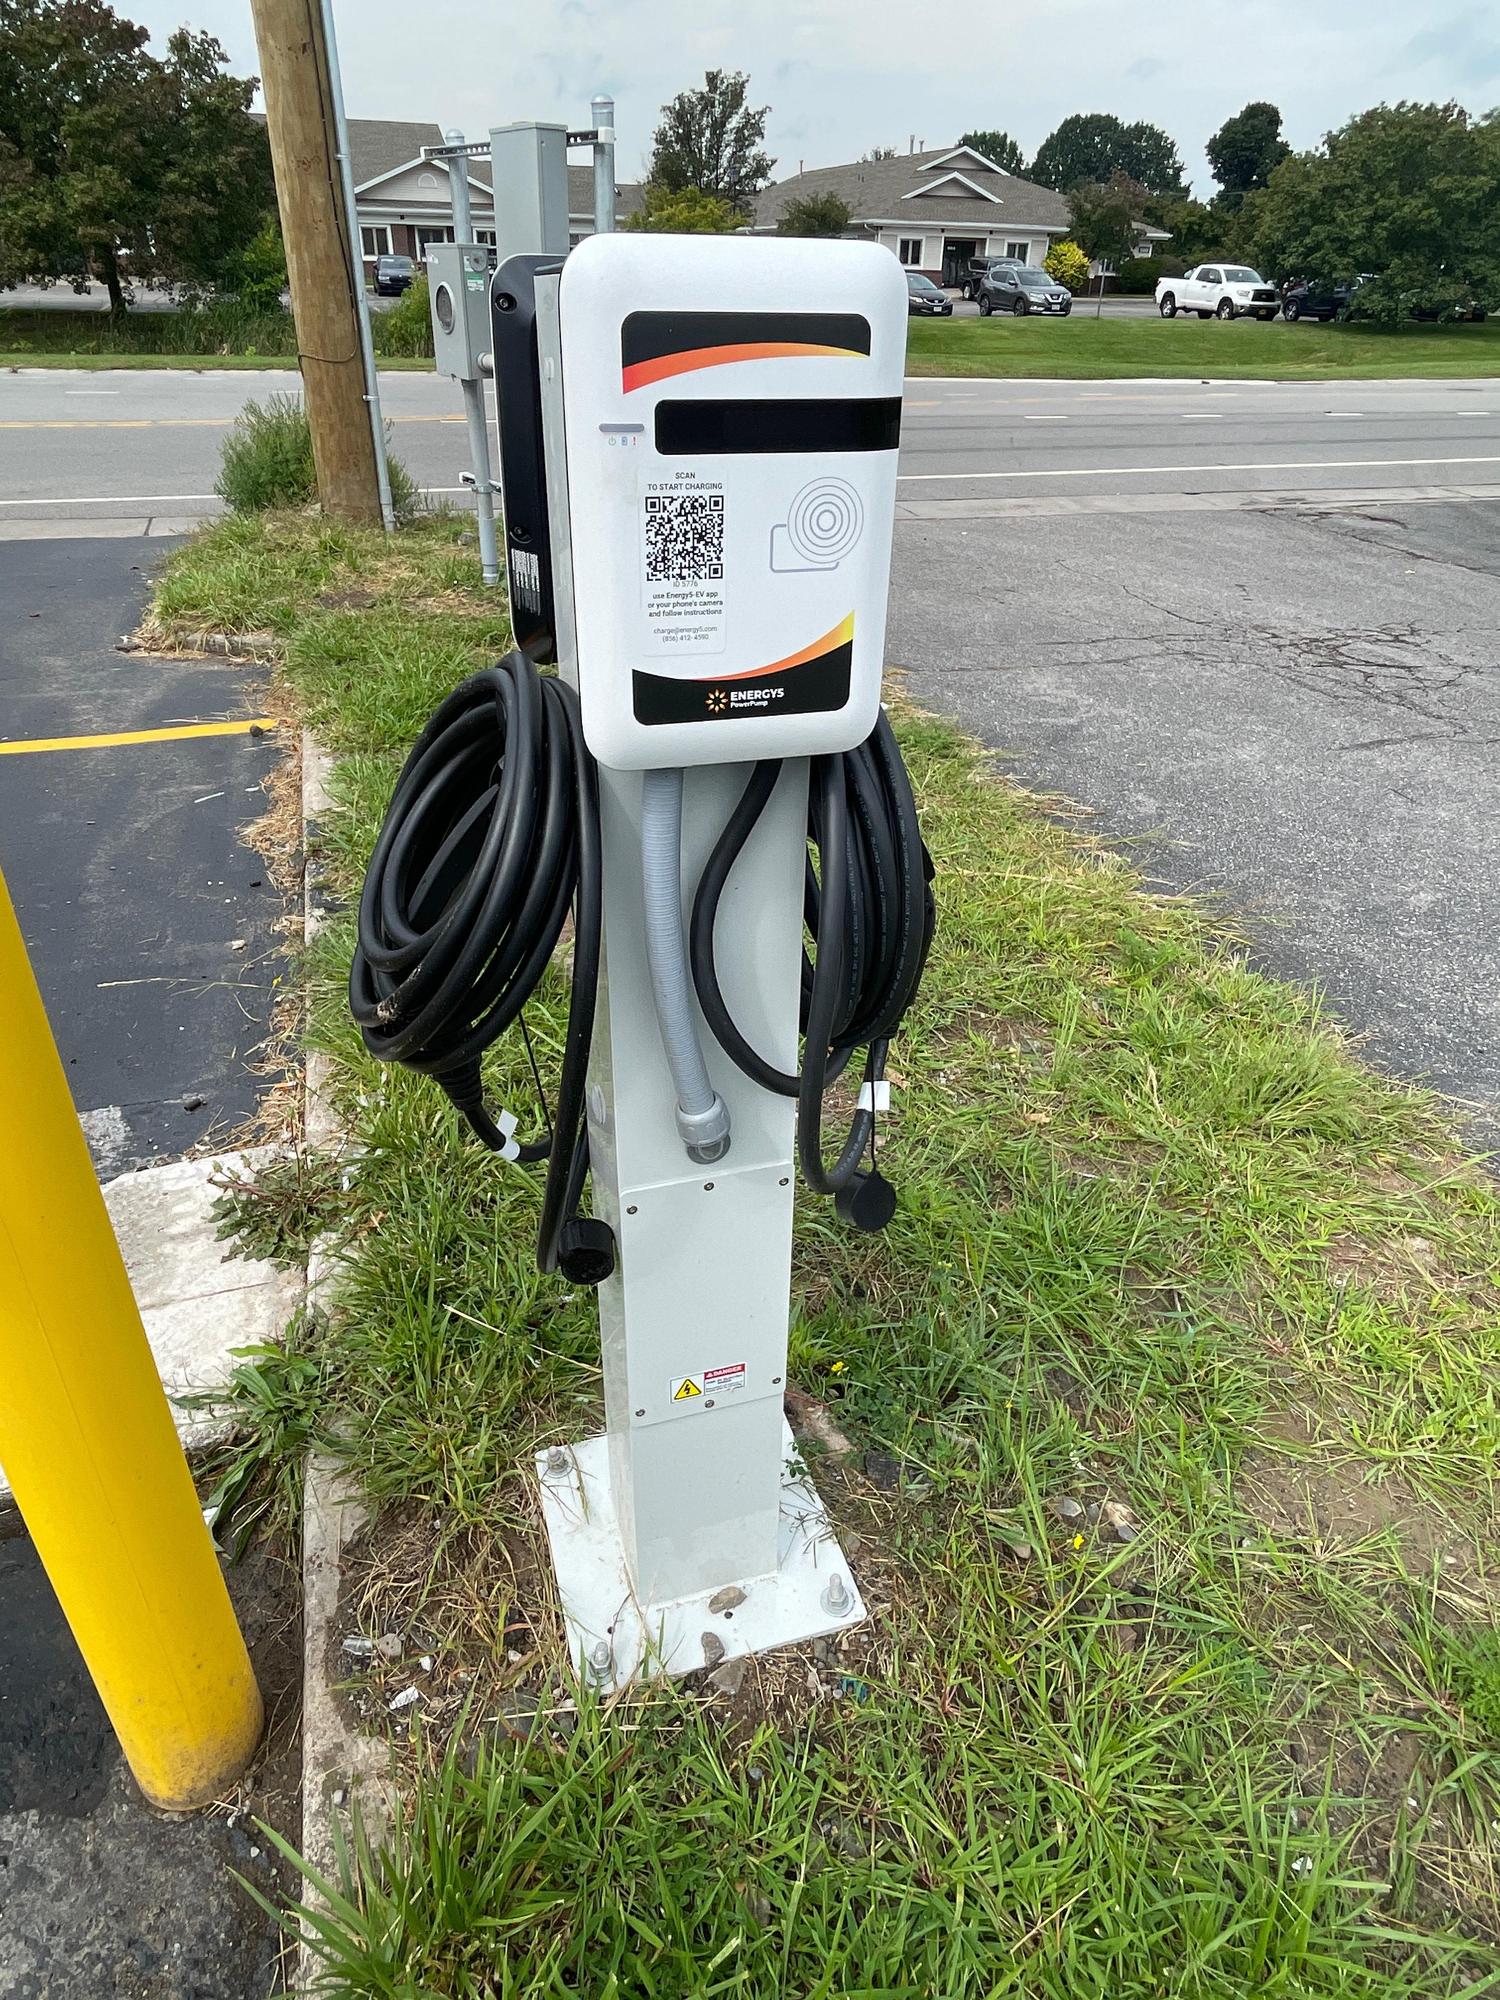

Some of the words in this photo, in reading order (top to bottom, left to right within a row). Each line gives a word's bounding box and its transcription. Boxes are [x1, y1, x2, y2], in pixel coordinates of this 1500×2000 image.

[672, 601, 698, 609] phone's
[730, 688, 784, 700] ENERGY5
[730, 700, 768, 708] PowerPump
